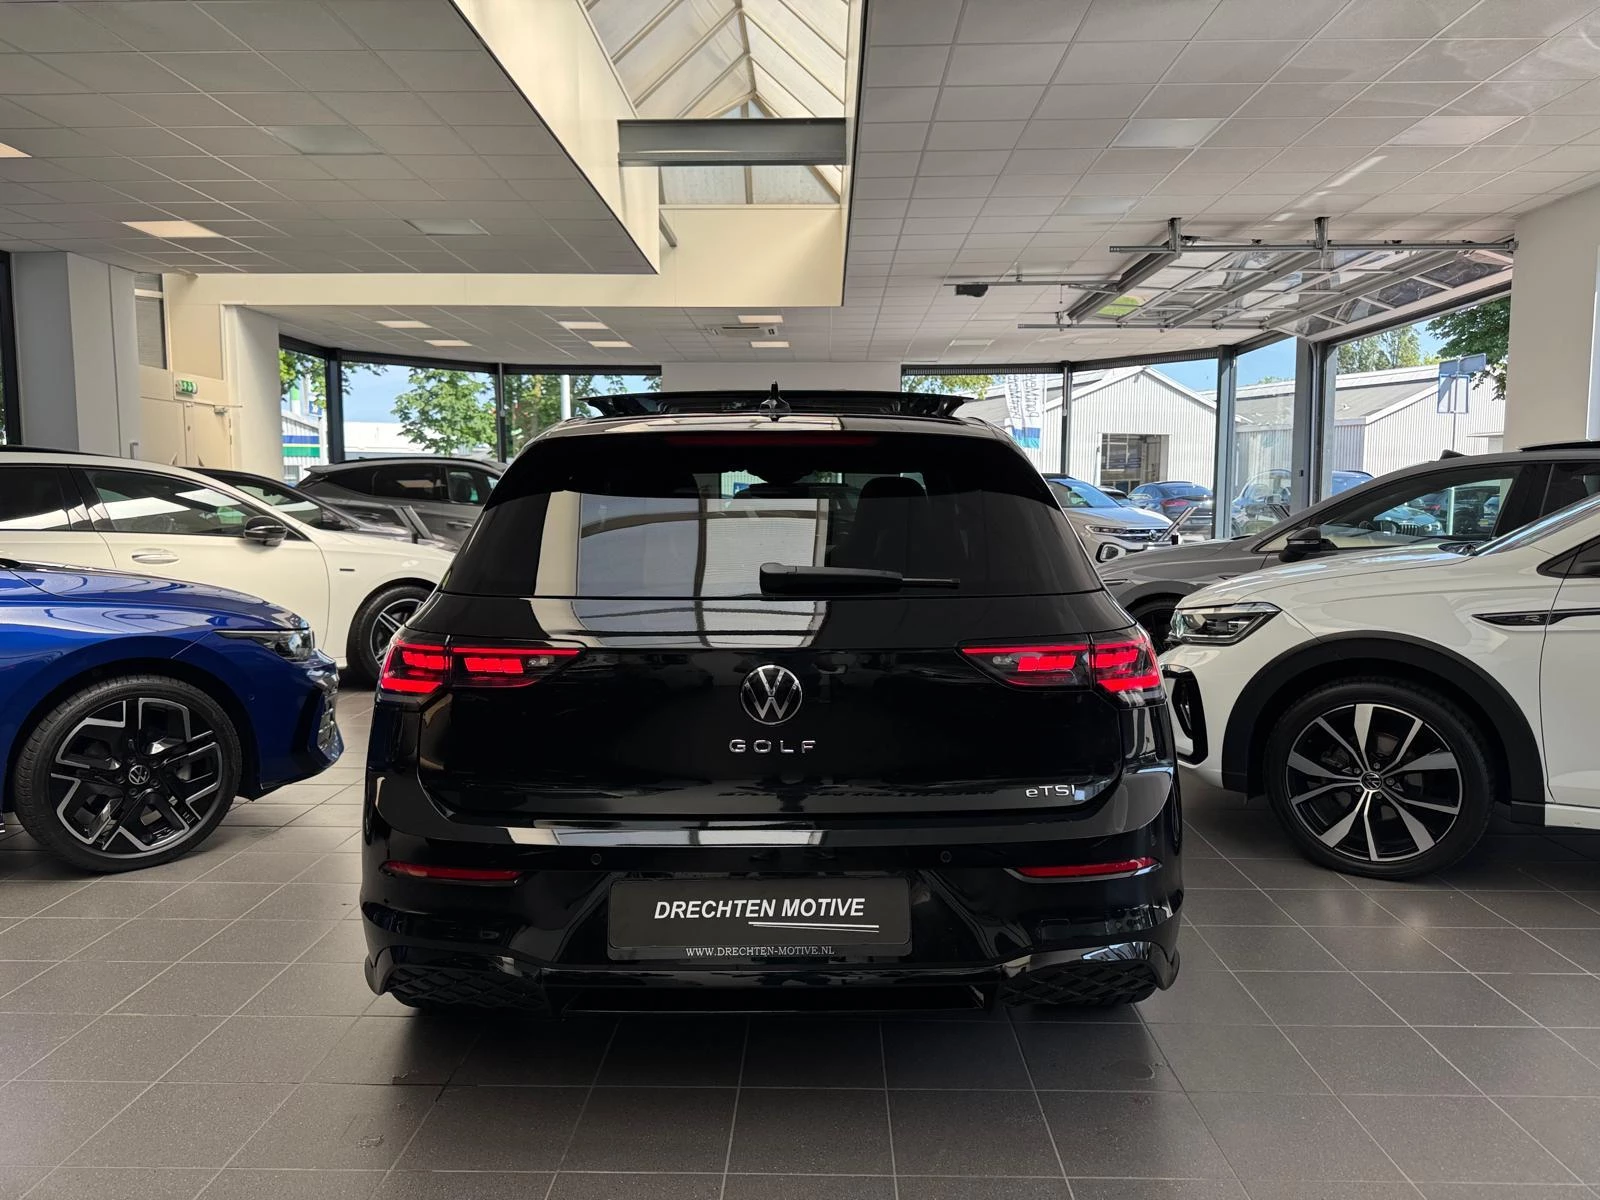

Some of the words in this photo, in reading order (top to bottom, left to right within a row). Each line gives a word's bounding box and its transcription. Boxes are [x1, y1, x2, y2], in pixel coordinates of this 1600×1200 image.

[729, 739, 816, 754] GOLF
[1025, 784, 1076, 798] eTSI
[654, 899, 776, 919] DRECHTEN
[782, 898, 866, 917] MOTIVE
[685, 946, 835, 957] WWW.DRECHTEN-MOTIVE.NL
